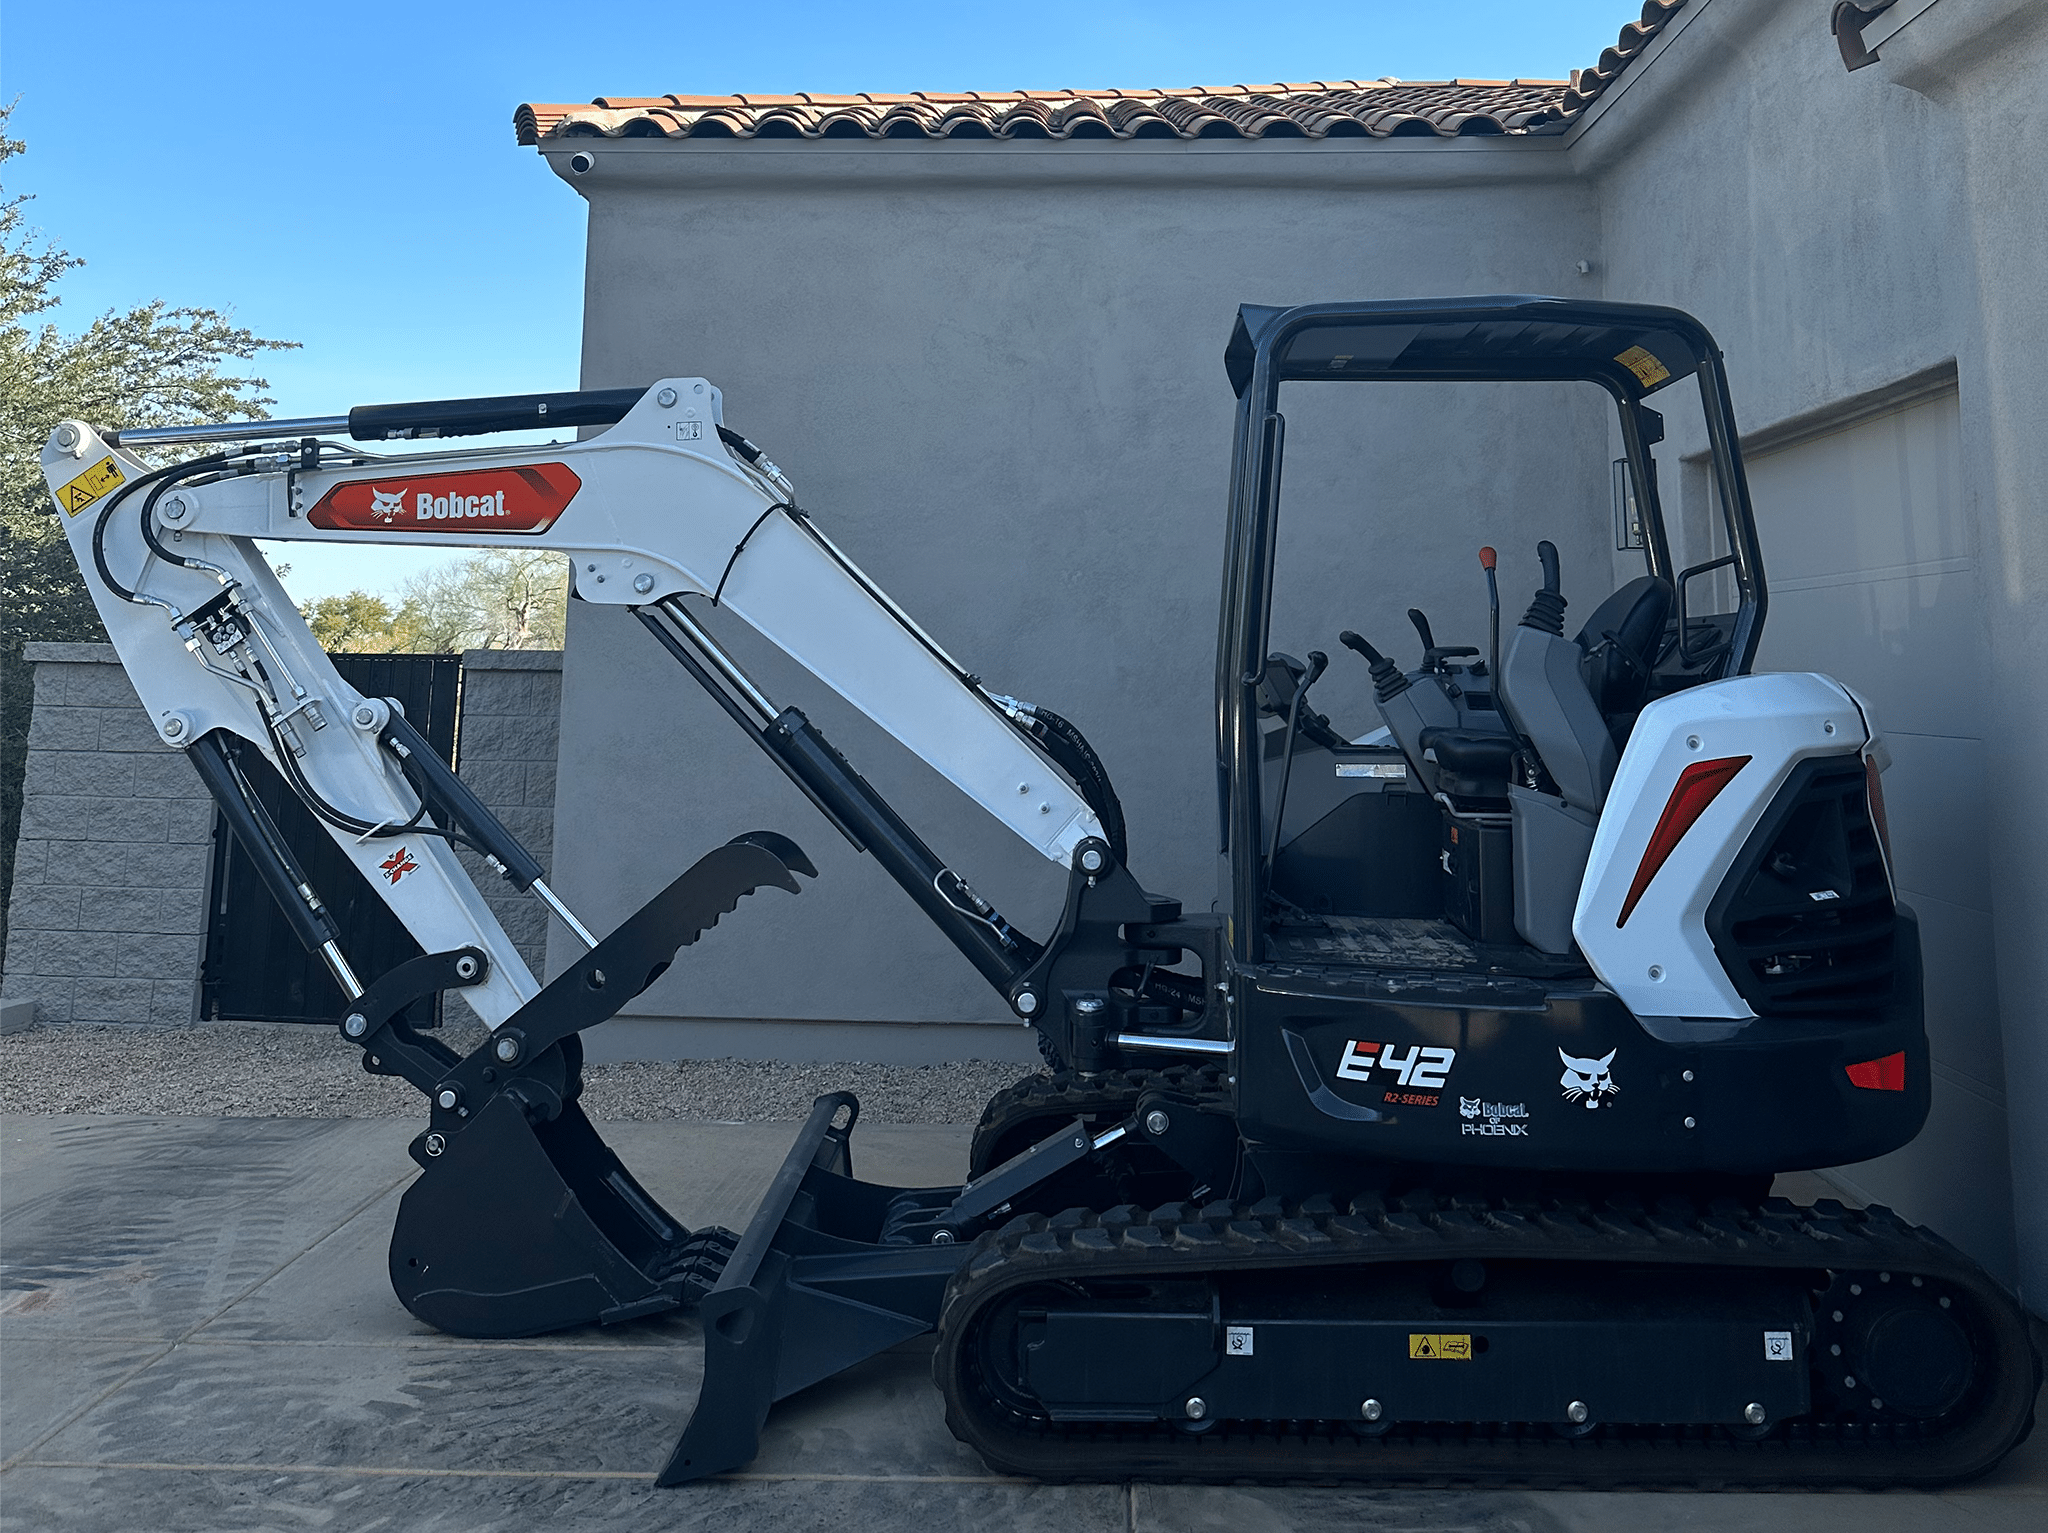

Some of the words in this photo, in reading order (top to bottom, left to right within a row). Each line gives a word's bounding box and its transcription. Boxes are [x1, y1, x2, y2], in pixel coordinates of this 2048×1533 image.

[416, 490, 505, 520] Bobcat
[1336, 1039, 1456, 1088] E42
[1384, 1092, 1440, 1107] R2-SERIES
[1482, 1102, 1527, 1118] Bobcat
[1461, 1123, 1529, 1136] PHOENIX
